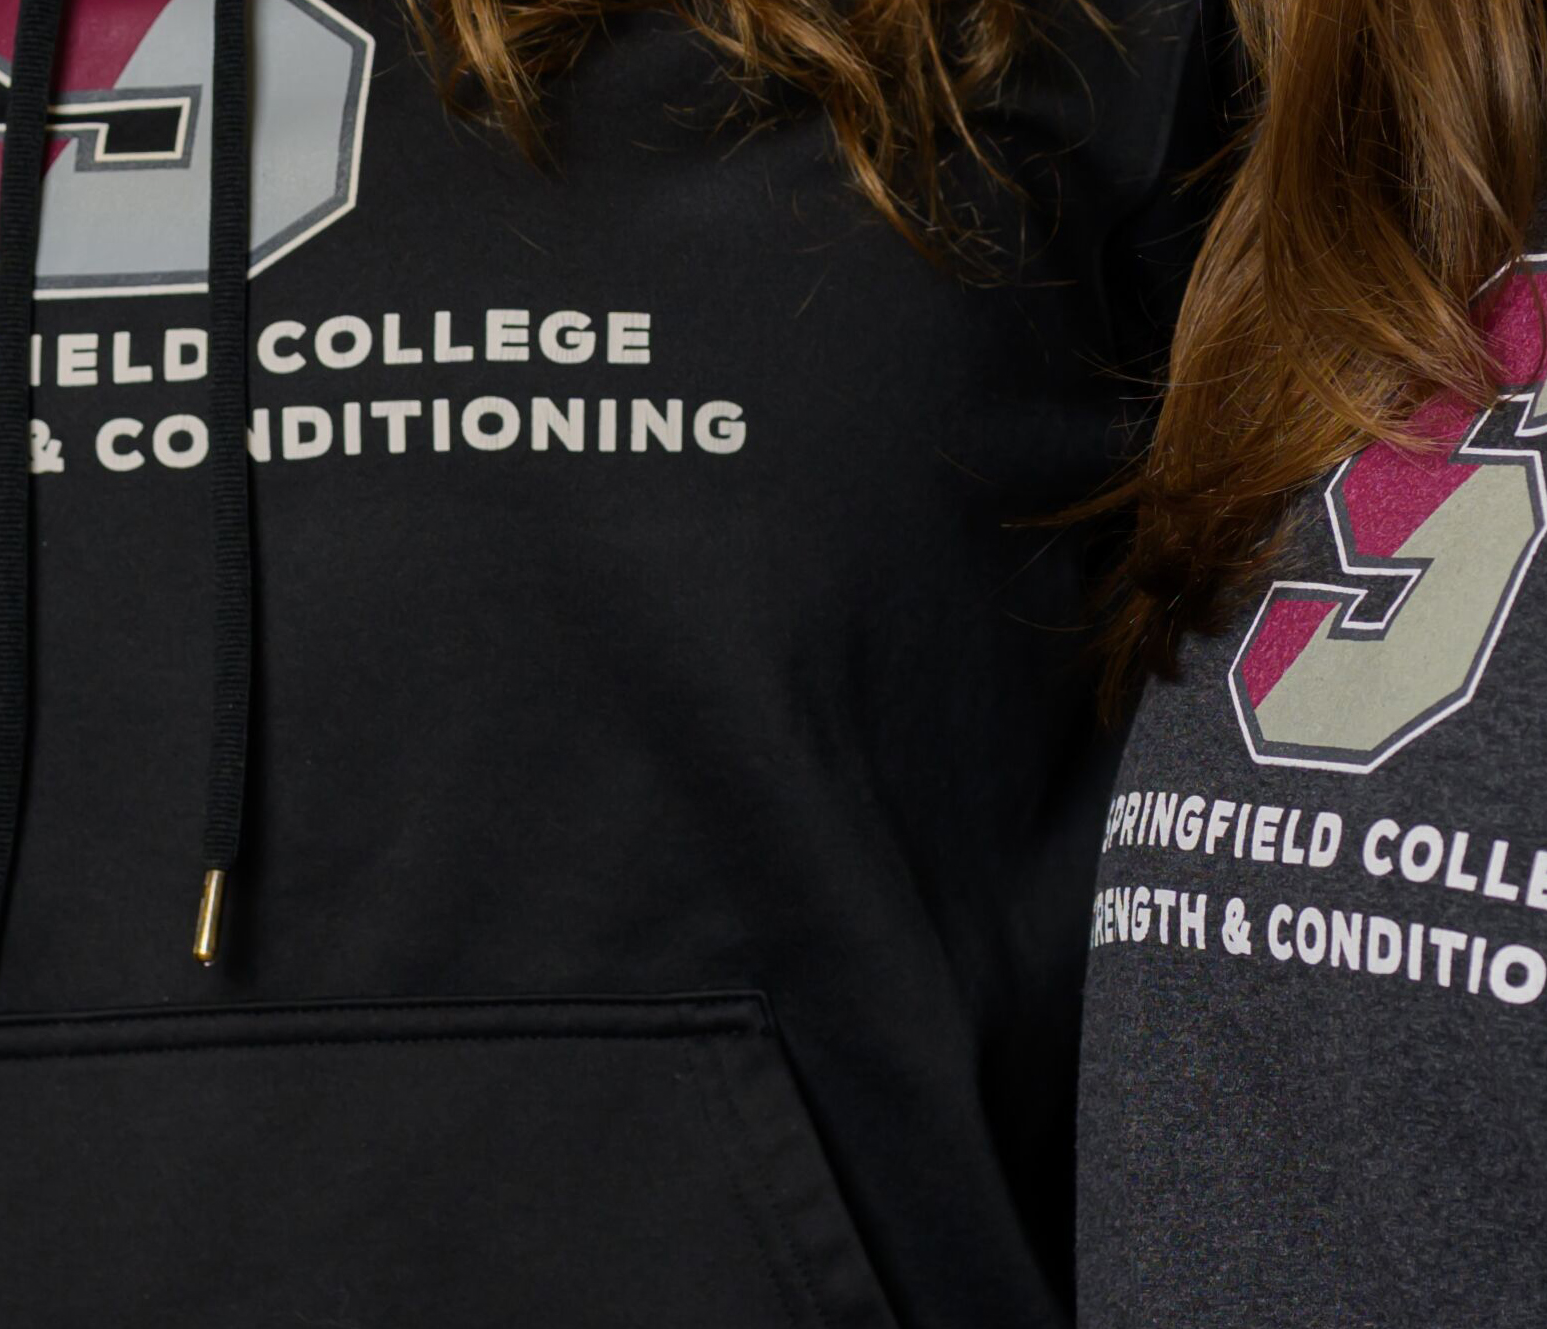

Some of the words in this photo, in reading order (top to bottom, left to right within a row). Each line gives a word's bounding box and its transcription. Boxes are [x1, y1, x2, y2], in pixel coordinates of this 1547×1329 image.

[257, 309, 651, 374] COLLEGE
[30, 418, 65, 474] &
[1090, 886, 1207, 950] RENGTH
[1222, 897, 1252, 955] &
